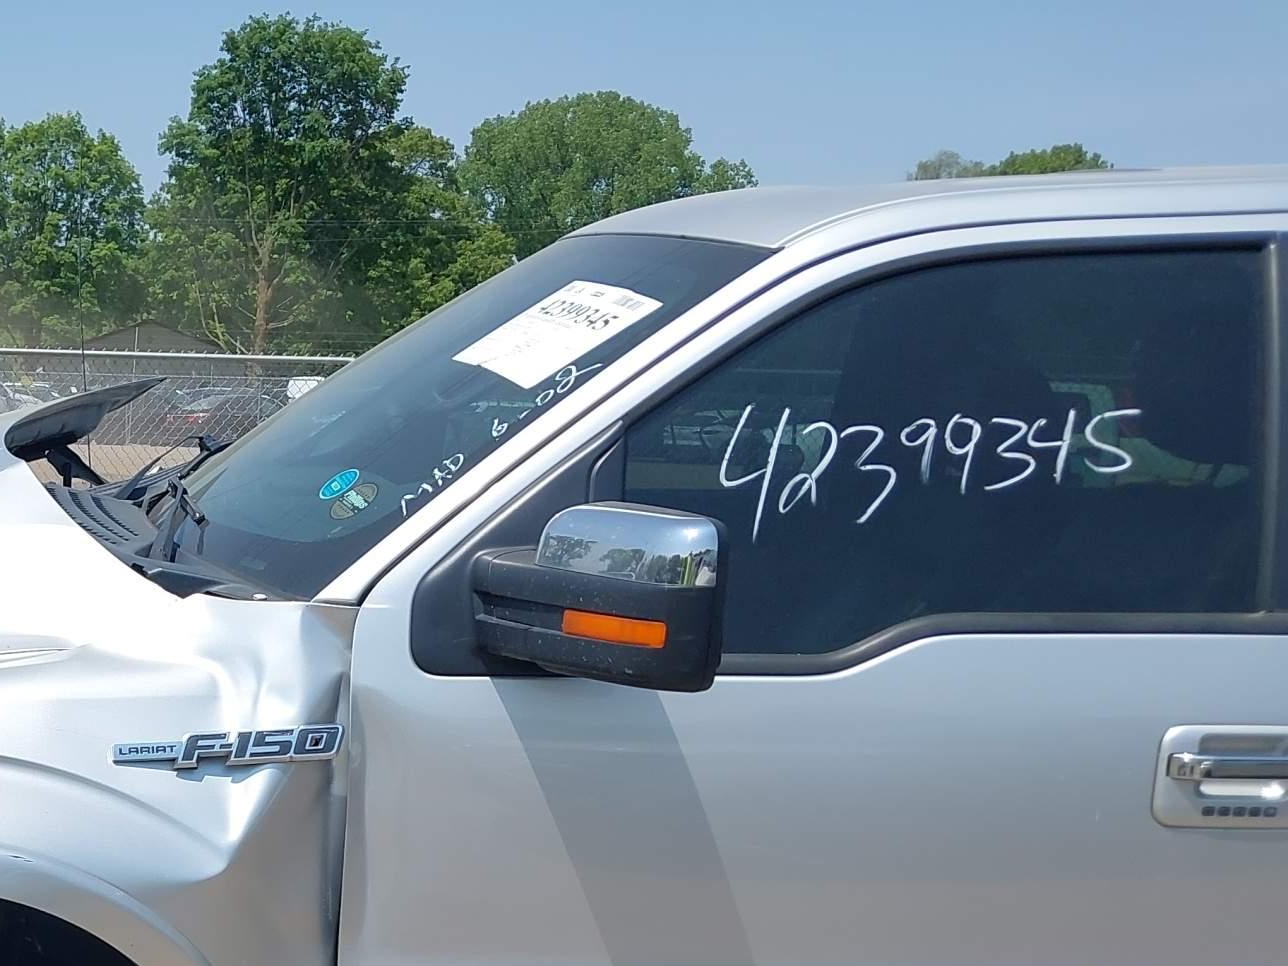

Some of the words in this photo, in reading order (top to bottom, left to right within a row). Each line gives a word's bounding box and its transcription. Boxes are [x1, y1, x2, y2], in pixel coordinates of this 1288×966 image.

[537, 298, 619, 330] 42399345
[718, 402, 1142, 543] 42399345
[118, 743, 177, 756] LARIAT
[178, 725, 343, 767] F-150
